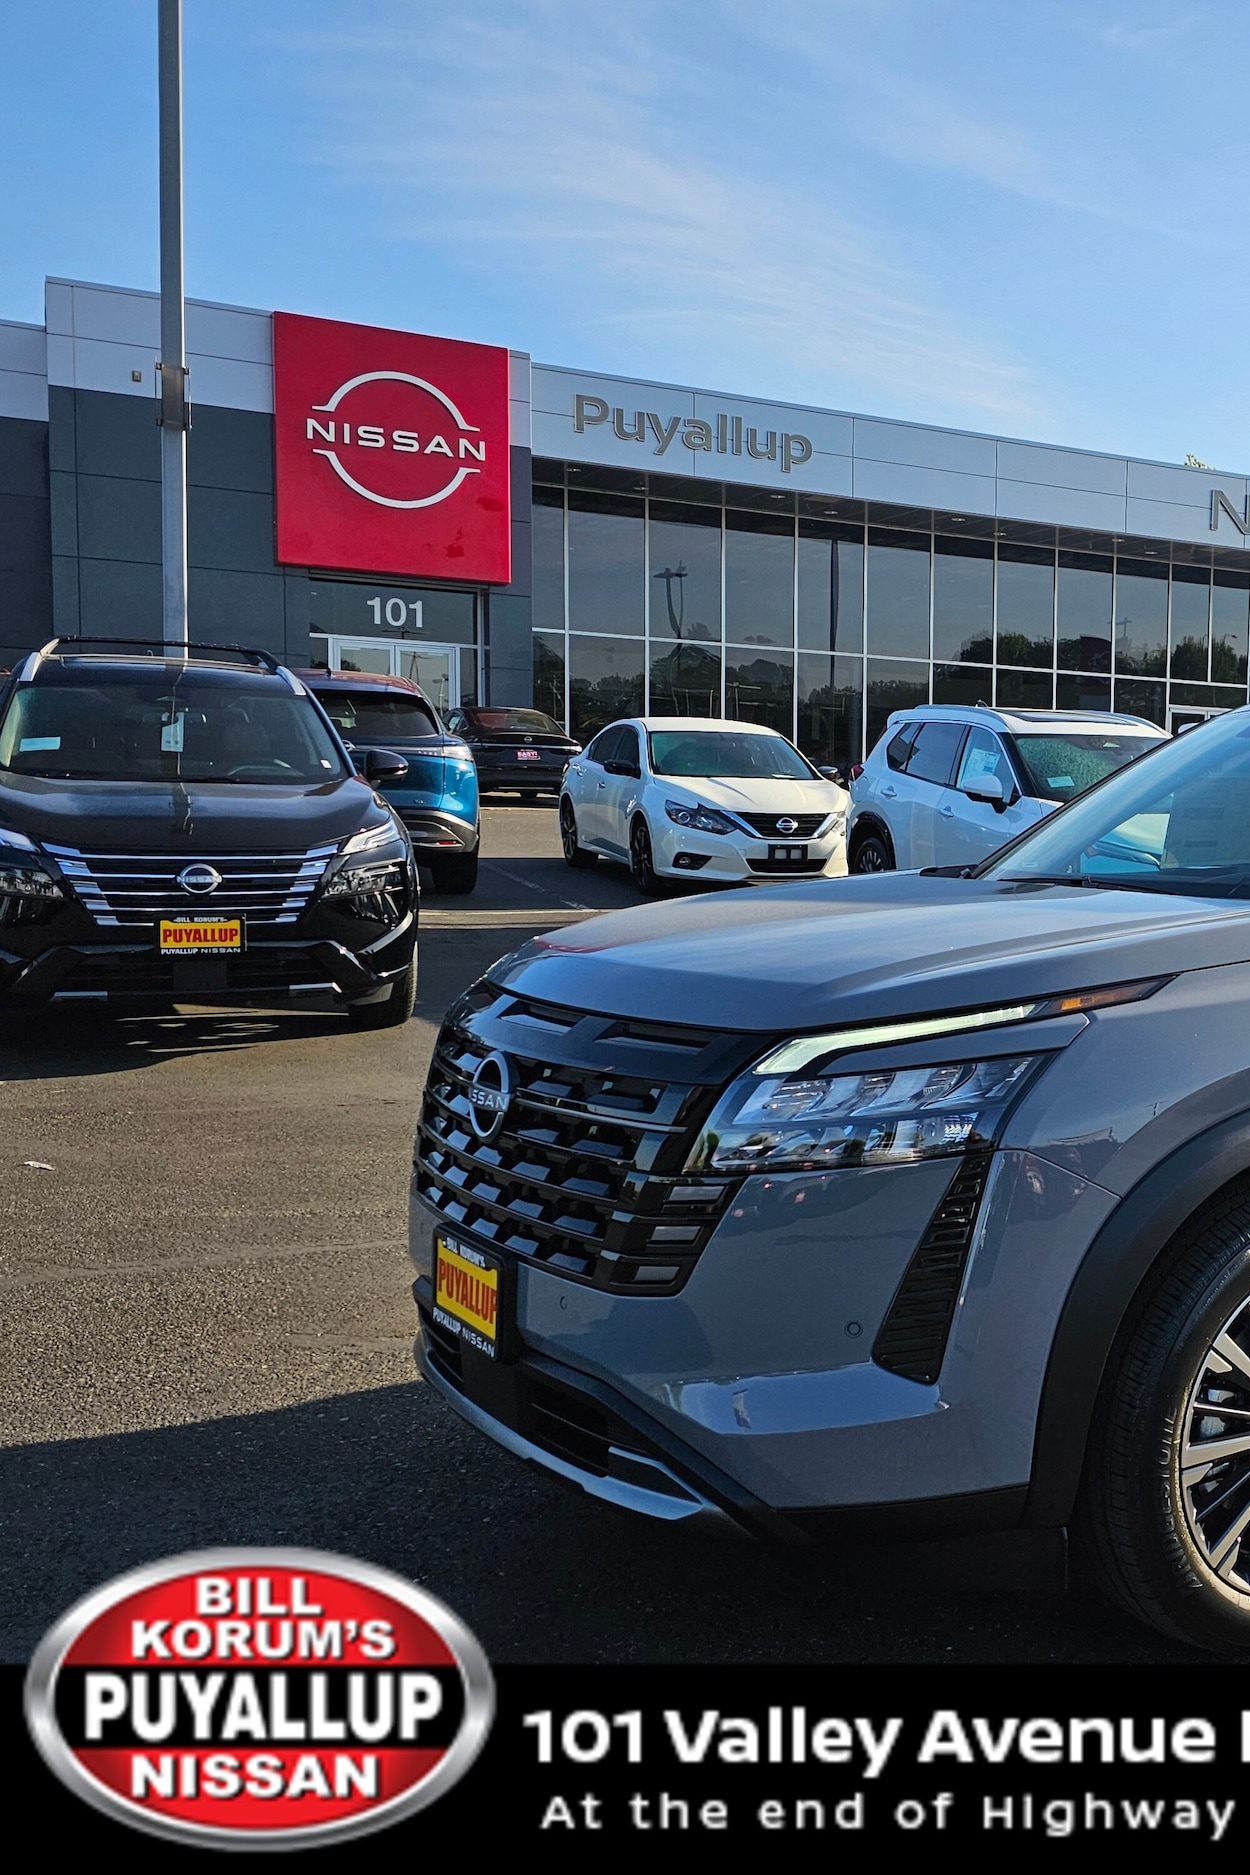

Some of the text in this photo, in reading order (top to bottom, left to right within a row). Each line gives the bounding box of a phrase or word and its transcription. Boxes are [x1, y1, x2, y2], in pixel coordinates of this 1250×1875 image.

[306, 417, 486, 462] NISSAN
[573, 393, 813, 473] Puyallup
[366, 596, 423, 628] 101
[162, 928, 238, 943] PUYALLUP
[471, 1089, 508, 1110] SSAN
[437, 1257, 497, 1325] PUYALLUP
[462, 1326, 495, 1358] NISSAN
